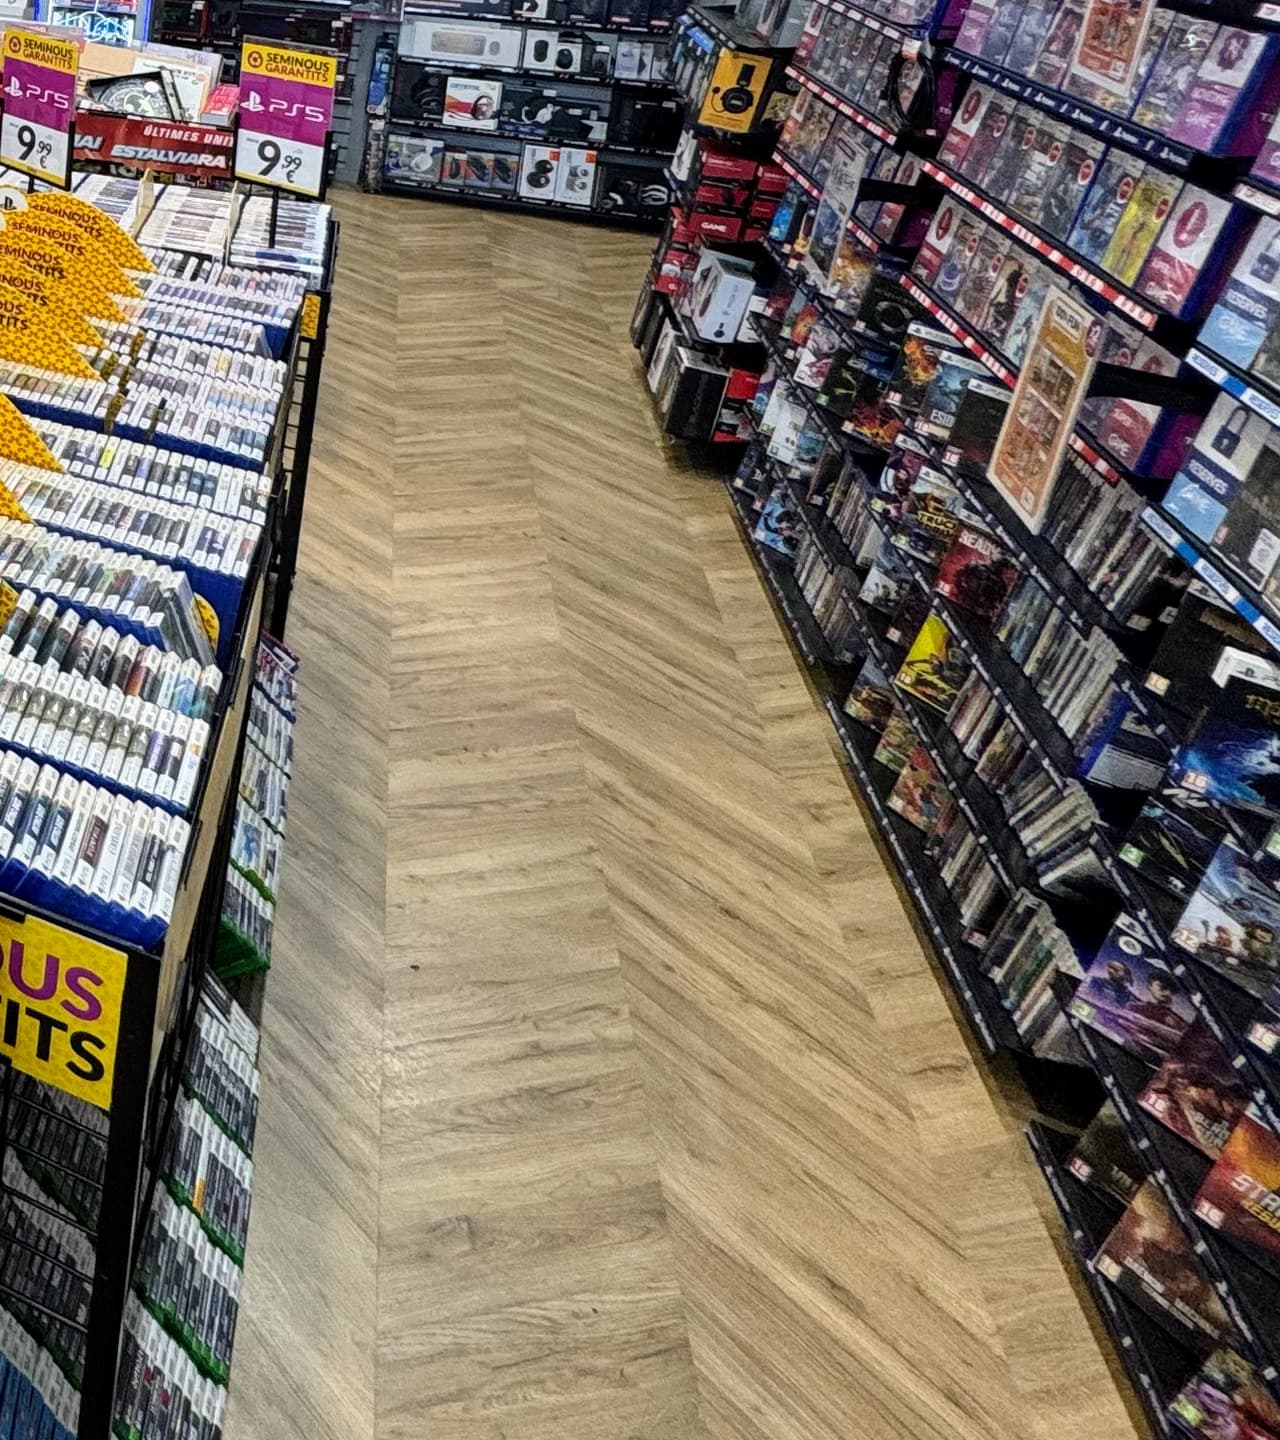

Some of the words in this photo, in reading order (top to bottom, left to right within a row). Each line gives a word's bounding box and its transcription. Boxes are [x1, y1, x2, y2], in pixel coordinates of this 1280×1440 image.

[23, 39, 73, 60] SEMINOUS
[23, 51, 72, 70] GARANTITS
[265, 52, 330, 73] SEMINOUS
[265, 63, 329, 83] GARANTITS
[26, 83, 70, 109] PS5
[269, 98, 324, 122] PS5
[143, 125, 200, 143] ÚLTIMES
[203, 131, 234, 146] UNIT
[110, 144, 226, 169] ESTALVIARA
[700, 220, 727, 233] GAME
